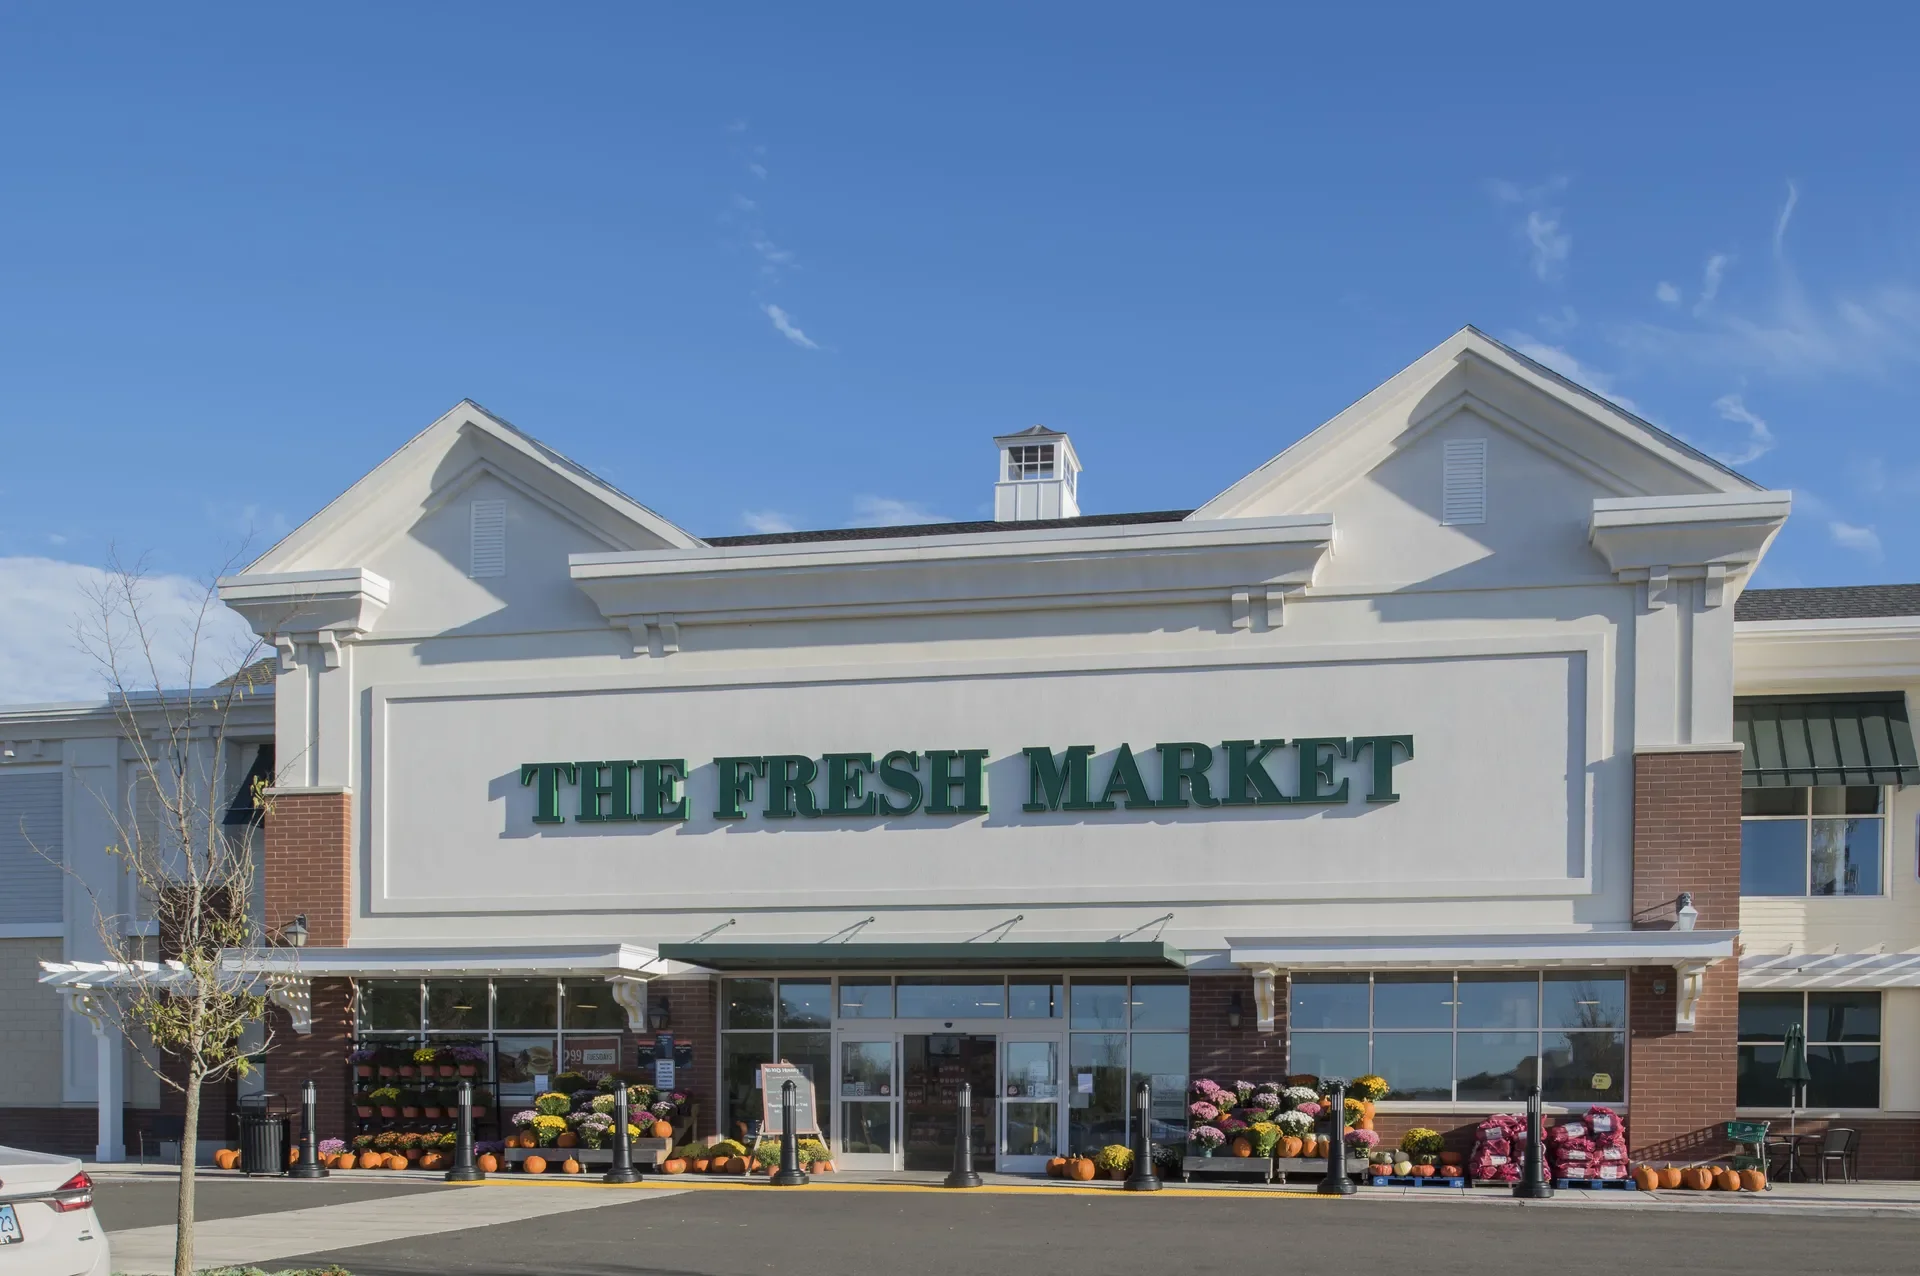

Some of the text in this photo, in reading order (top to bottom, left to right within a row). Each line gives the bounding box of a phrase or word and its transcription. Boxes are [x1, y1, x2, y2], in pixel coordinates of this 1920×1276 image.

[521, 734, 1415, 823] THE FRESH MARKET
[586, 1053, 613, 1062] TUESDAYS
